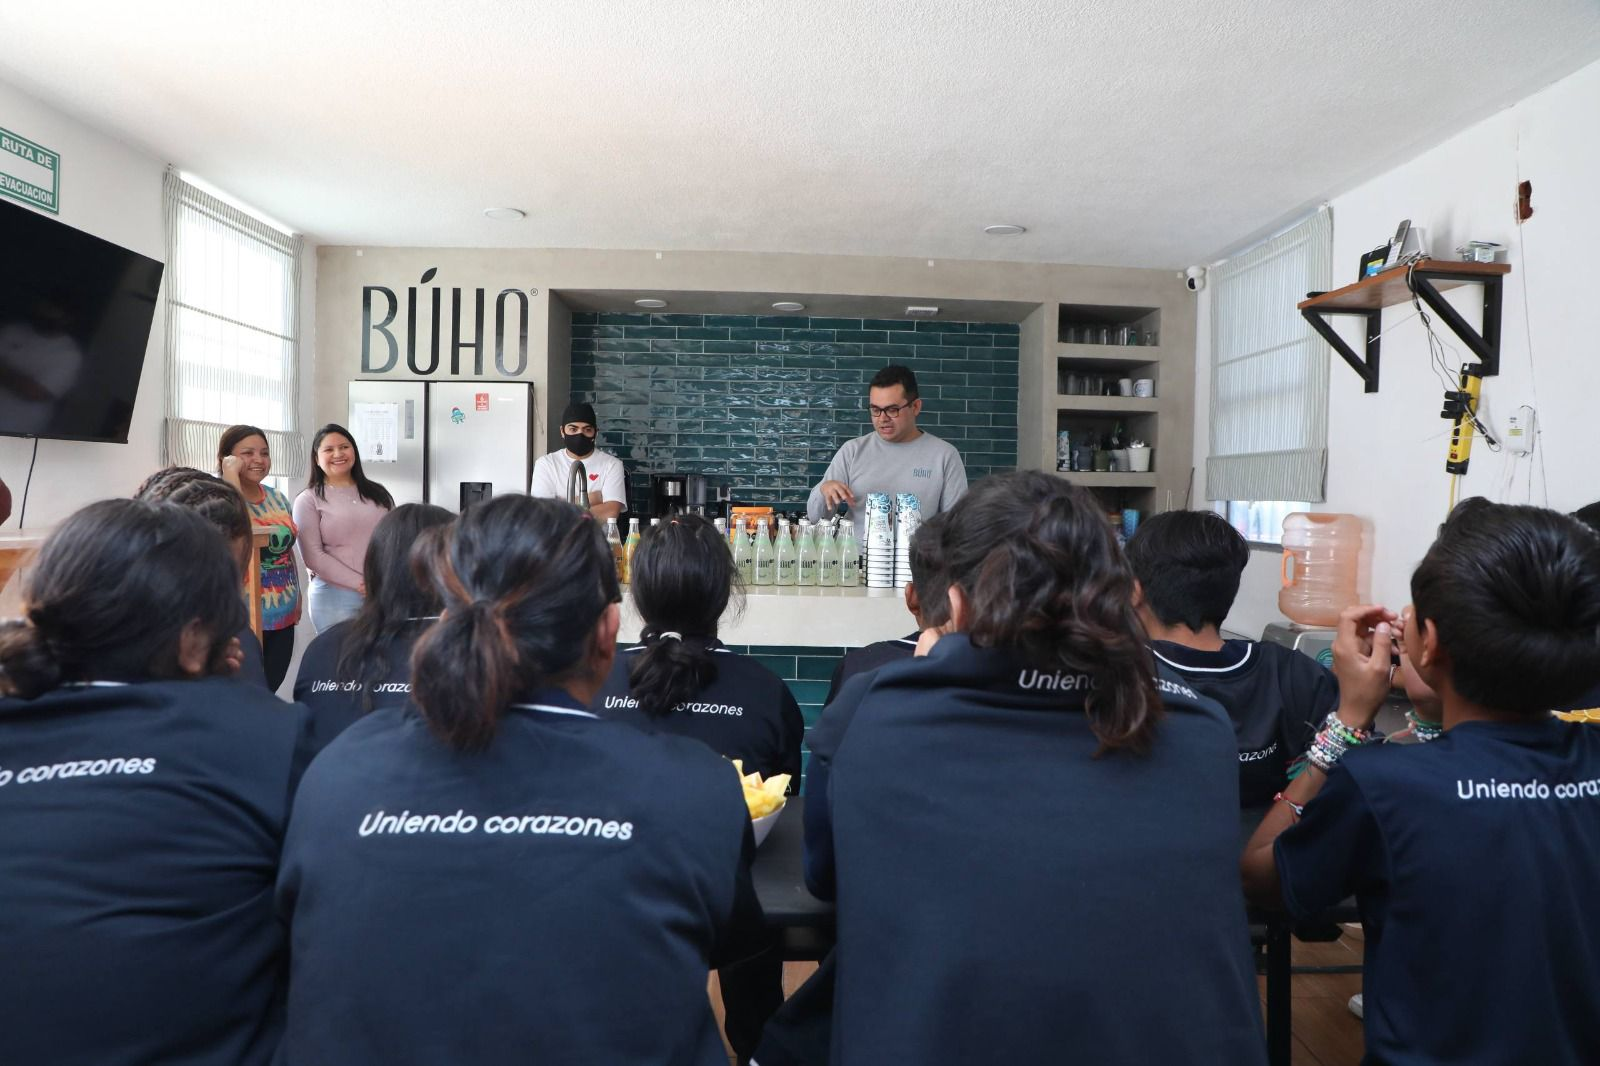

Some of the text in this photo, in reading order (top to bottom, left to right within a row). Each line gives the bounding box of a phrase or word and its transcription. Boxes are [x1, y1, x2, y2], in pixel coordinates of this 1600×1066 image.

[1, 137, 52, 168] RUTA DE
[0, 175, 52, 205] EVACUACION
[1018, 669, 1095, 690] Unien
[604, 696, 743, 716] Unie orazones
[16, 757, 157, 784] corazones
[1457, 778, 1600, 799] Uniendo cora
[358, 809, 634, 840] Uniendo corazones
